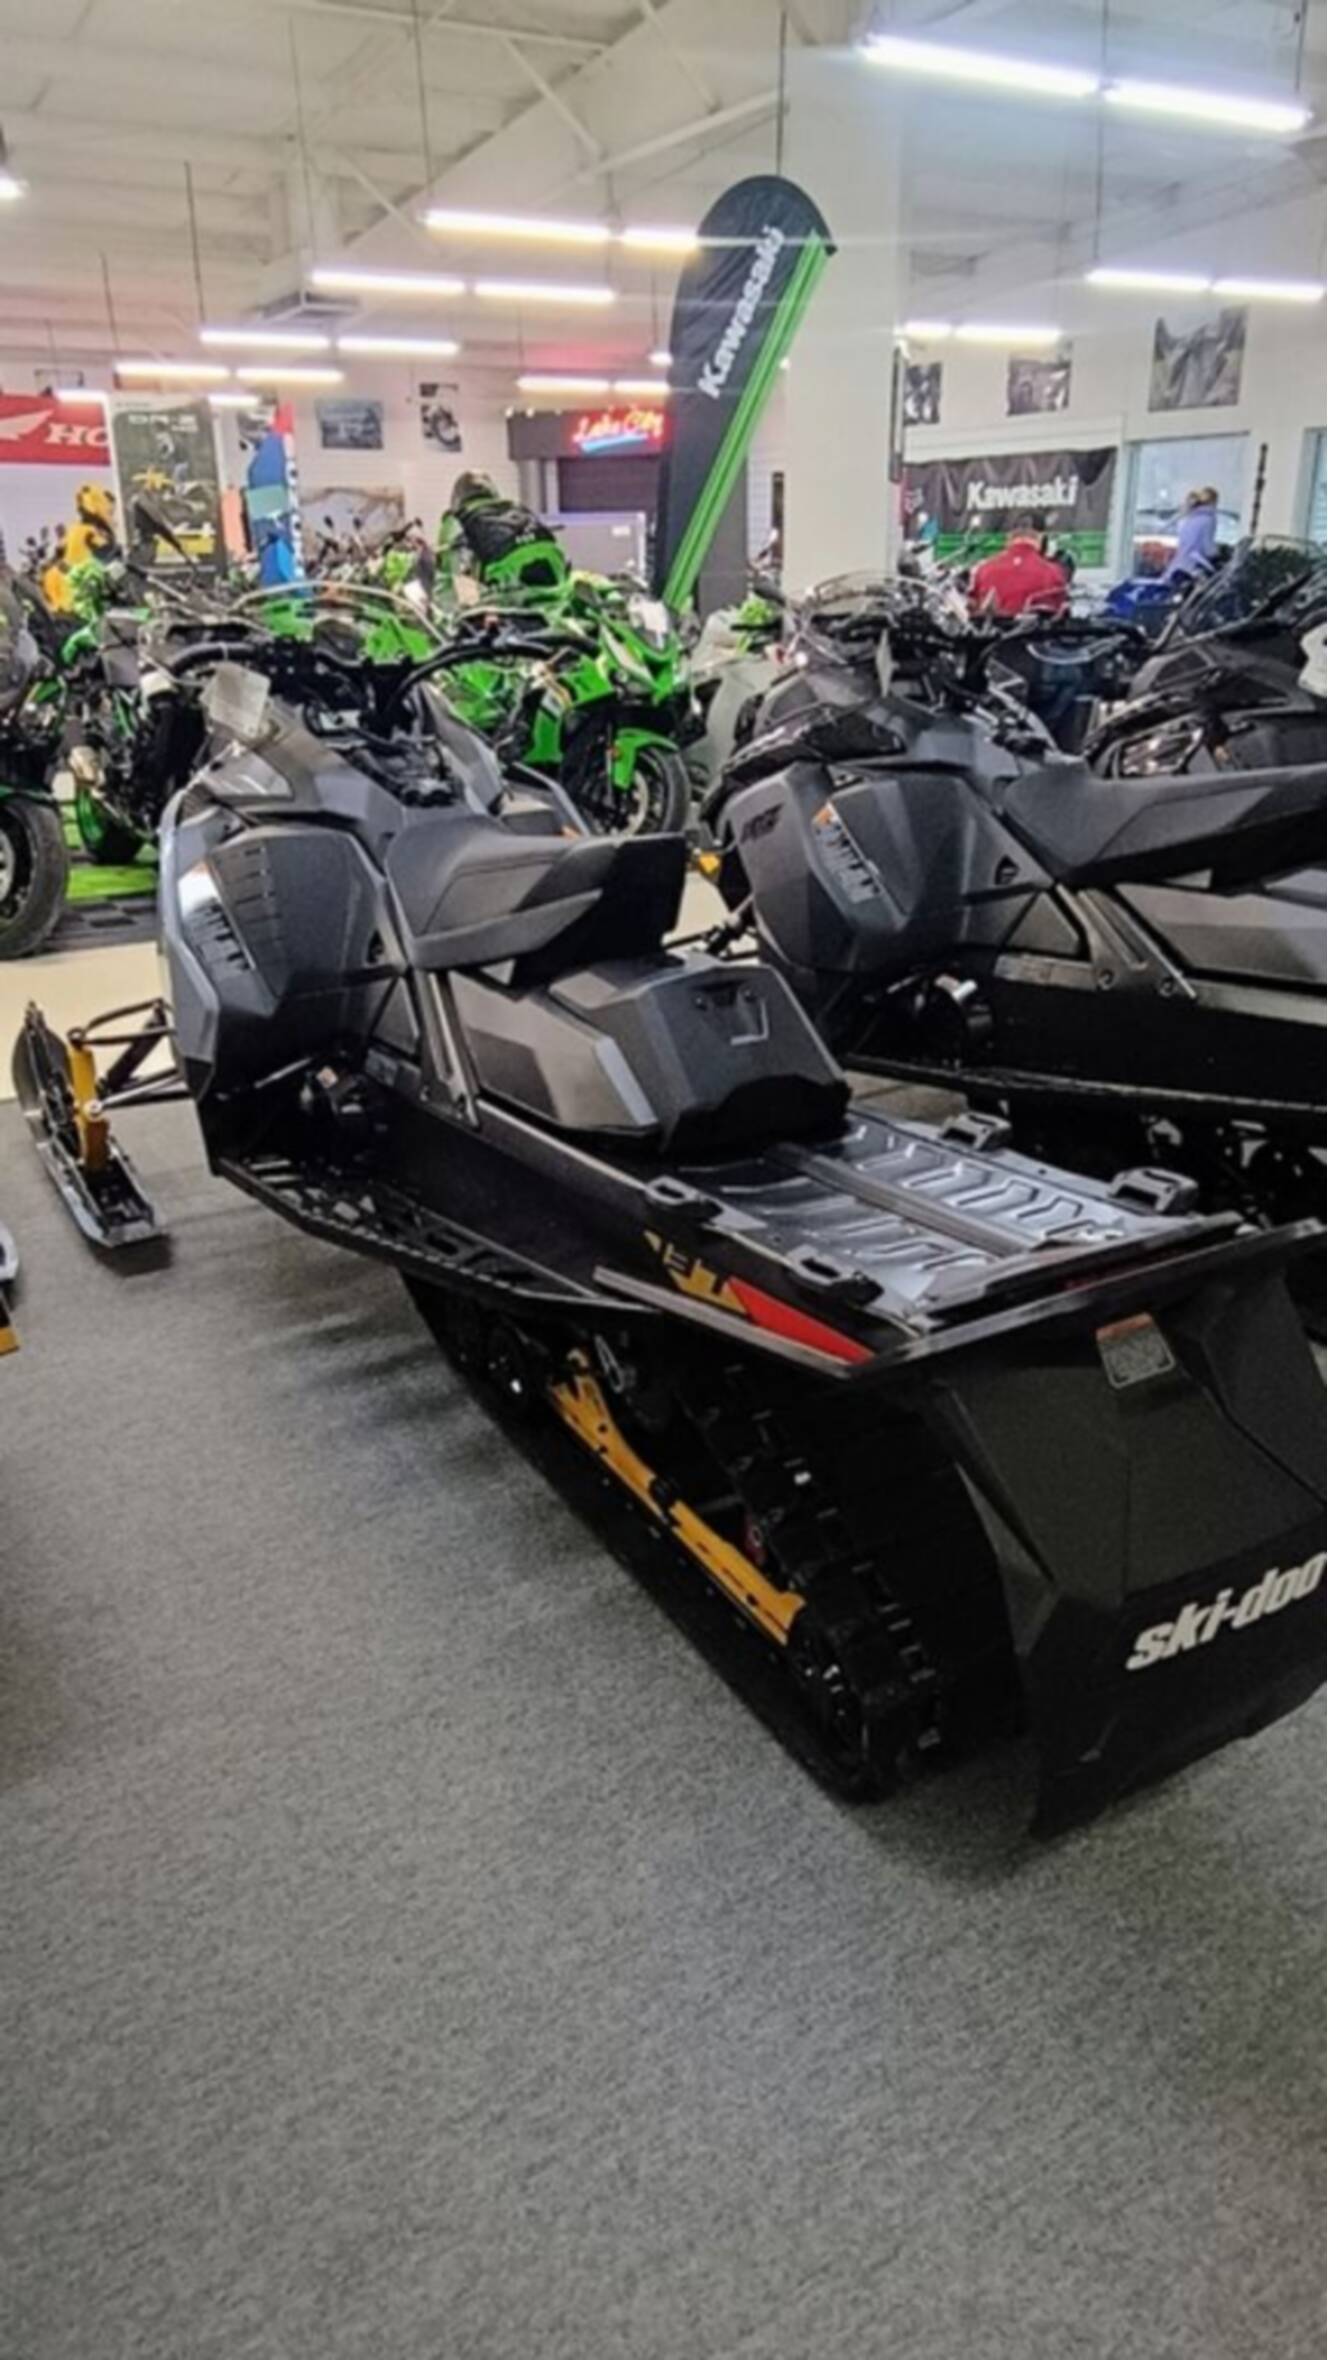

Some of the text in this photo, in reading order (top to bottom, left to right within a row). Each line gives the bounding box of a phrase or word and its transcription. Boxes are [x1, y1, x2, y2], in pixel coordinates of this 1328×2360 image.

[697, 224, 785, 399] Kawasaki
[966, 474, 1079, 510] Kawasaki
[1125, 1551, 1328, 1671] ski-doo
